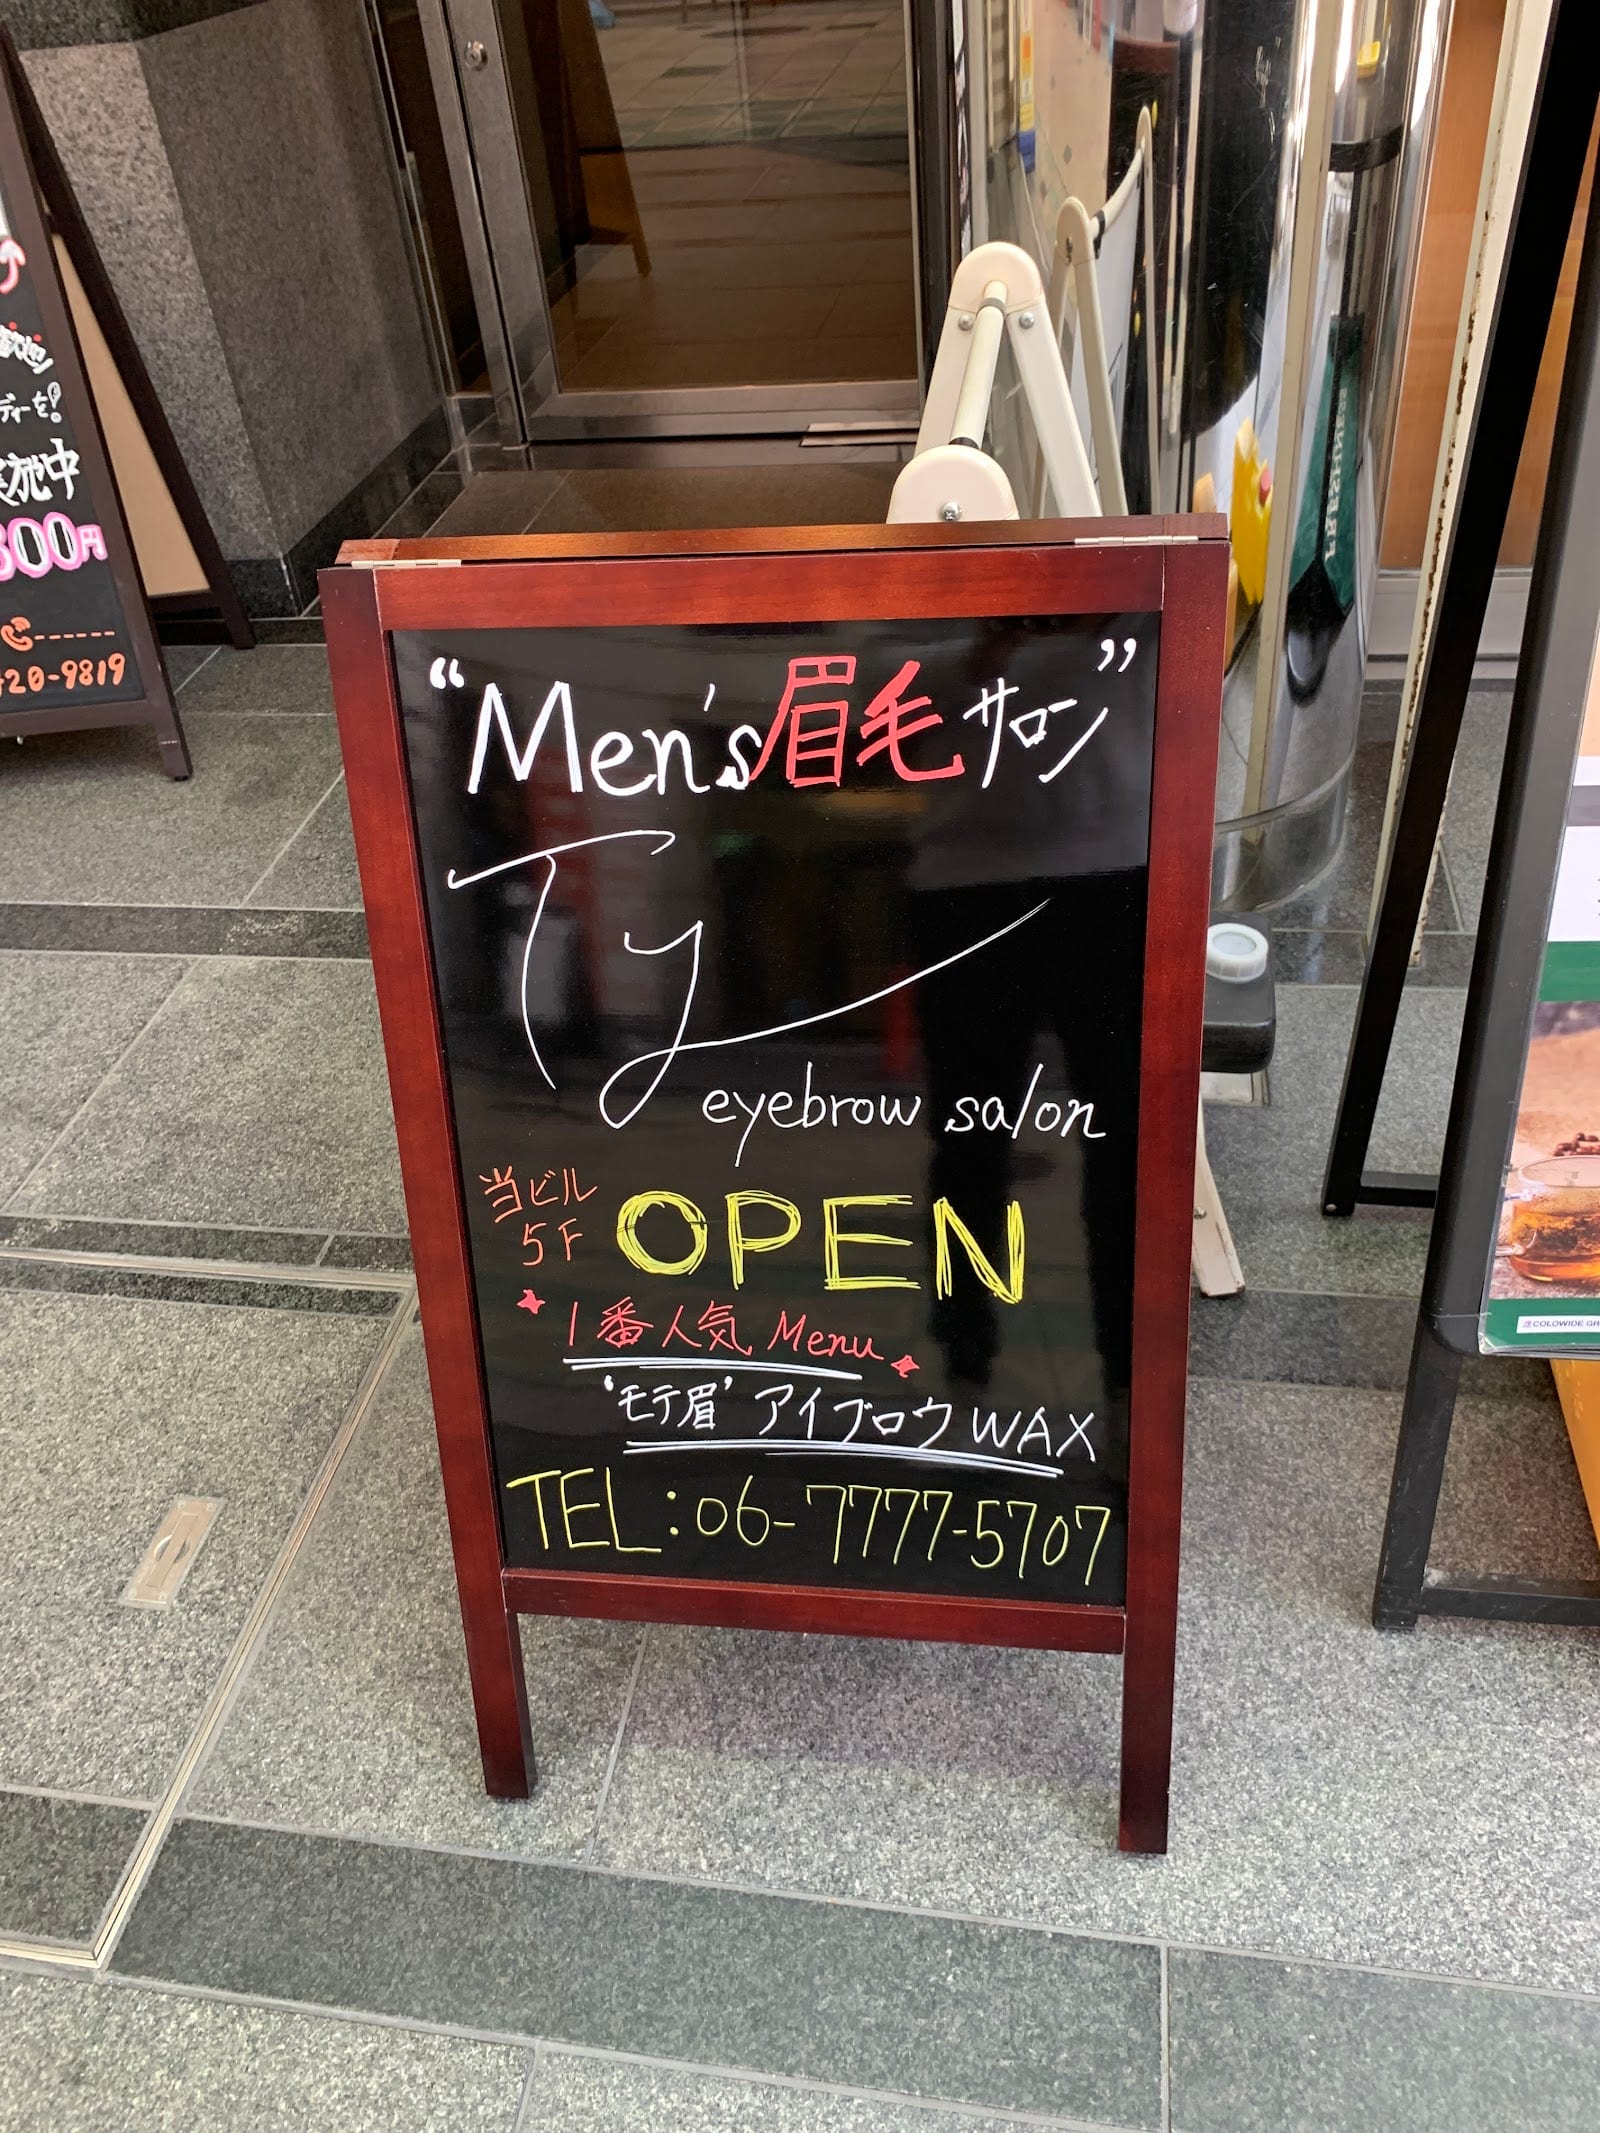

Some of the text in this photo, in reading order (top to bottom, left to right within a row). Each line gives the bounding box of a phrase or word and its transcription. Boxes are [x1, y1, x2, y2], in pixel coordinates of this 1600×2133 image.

[0, 652, 126, 695] 20-9819
[702, 1061, 1106, 1168] eyebrow salon
[478, 1166, 598, 1223] 当ビル
[522, 1216, 584, 1267] 5F
[616, 1189, 1026, 1304] OPEN
[569, 1296, 885, 1361] 1番人気 Menu
[1532, 1319, 1584, 1329] COLOWIDE
[970, 1408, 1097, 1463] WAX
